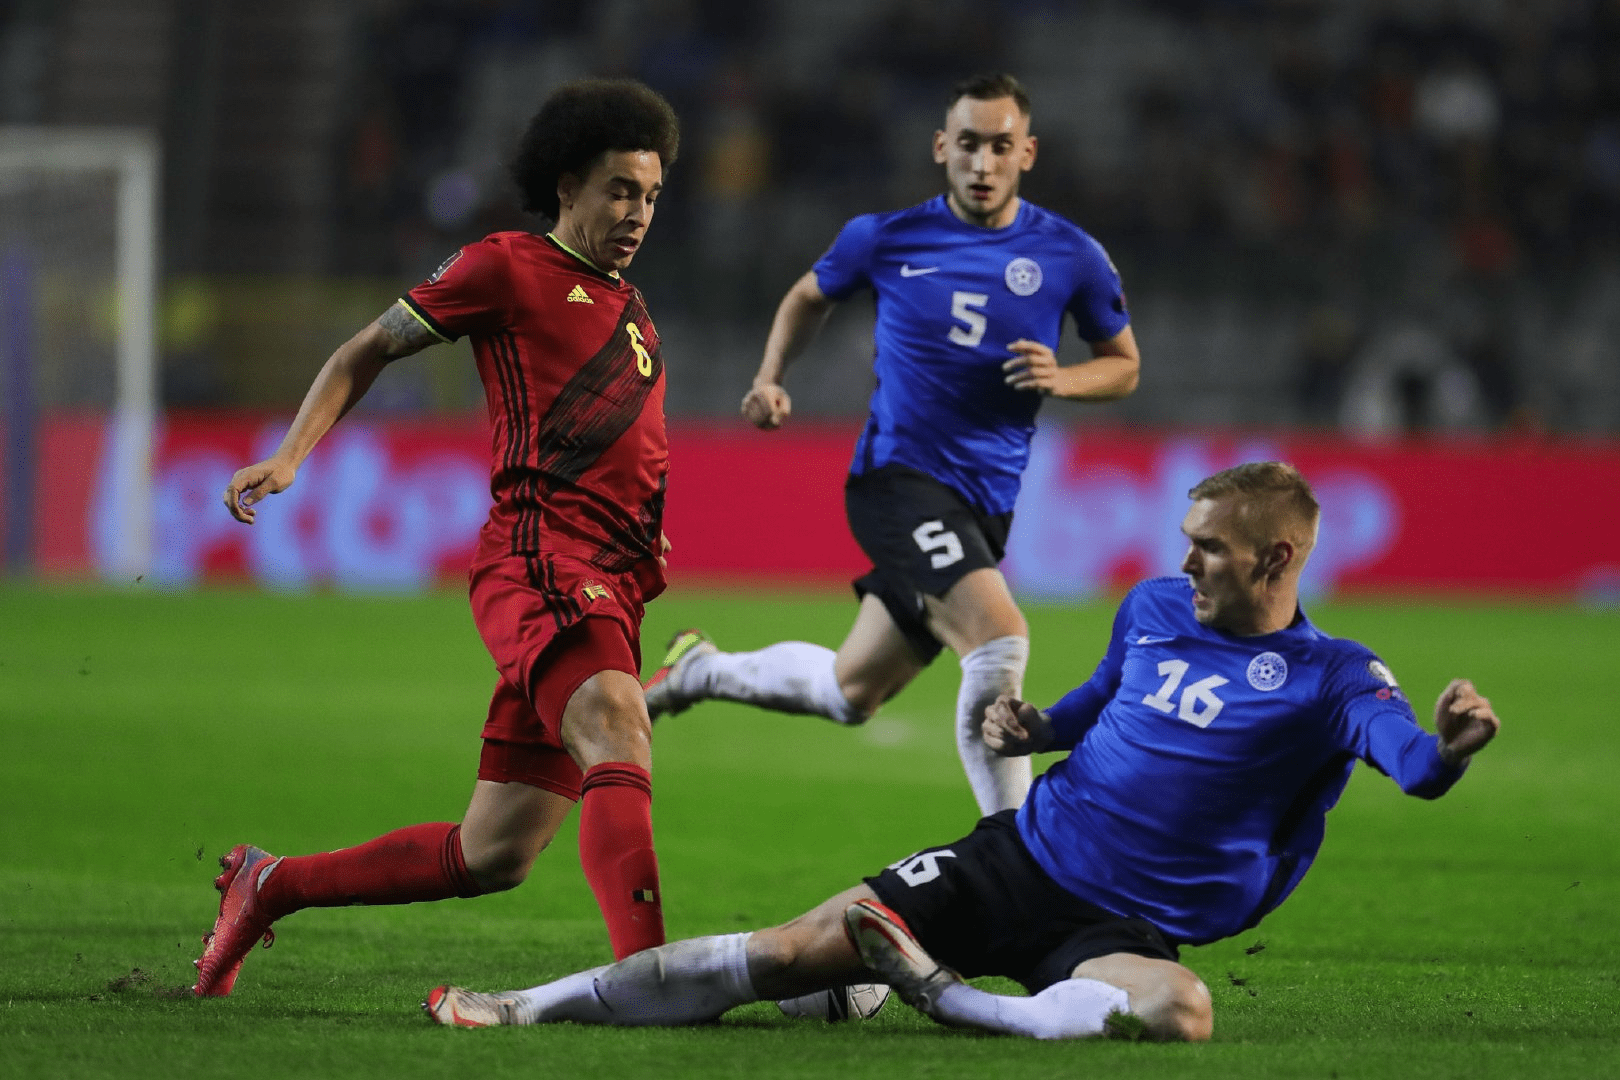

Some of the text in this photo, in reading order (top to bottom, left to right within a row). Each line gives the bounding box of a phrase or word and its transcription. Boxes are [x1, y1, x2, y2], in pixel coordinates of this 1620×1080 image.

[947, 291, 988, 348] 5
[626, 322, 652, 377] 6
[912, 520, 965, 569] 5
[1141, 659, 1230, 729] 16
